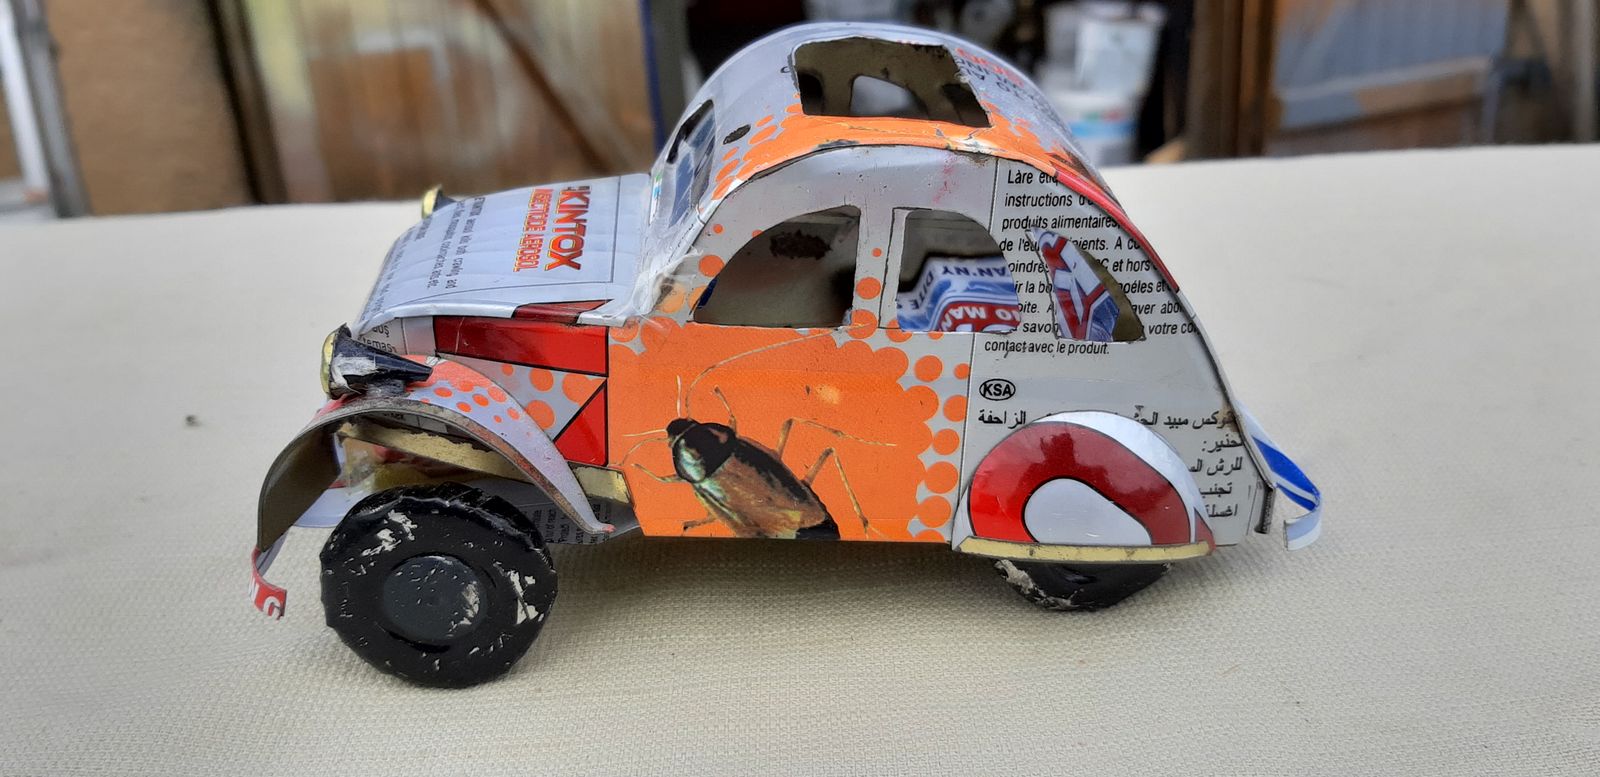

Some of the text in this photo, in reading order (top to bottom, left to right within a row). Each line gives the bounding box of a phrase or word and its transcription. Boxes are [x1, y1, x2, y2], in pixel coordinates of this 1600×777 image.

[1005, 193, 1072, 207] instructions
[545, 191, 591, 271] KINTOX
[1002, 216, 1048, 232] produits
[1000, 238, 1013, 251] de
[1115, 237, 1123, 250] A
[513, 233, 545, 272] AEROSOL
[1112, 261, 1123, 272] et
[1126, 258, 1150, 272] hors
[1025, 280, 1035, 293] la
[1149, 322, 1178, 335] votre
[1028, 343, 1054, 353] avec
[1056, 340, 1066, 353] le
[983, 383, 1012, 397] KSA
